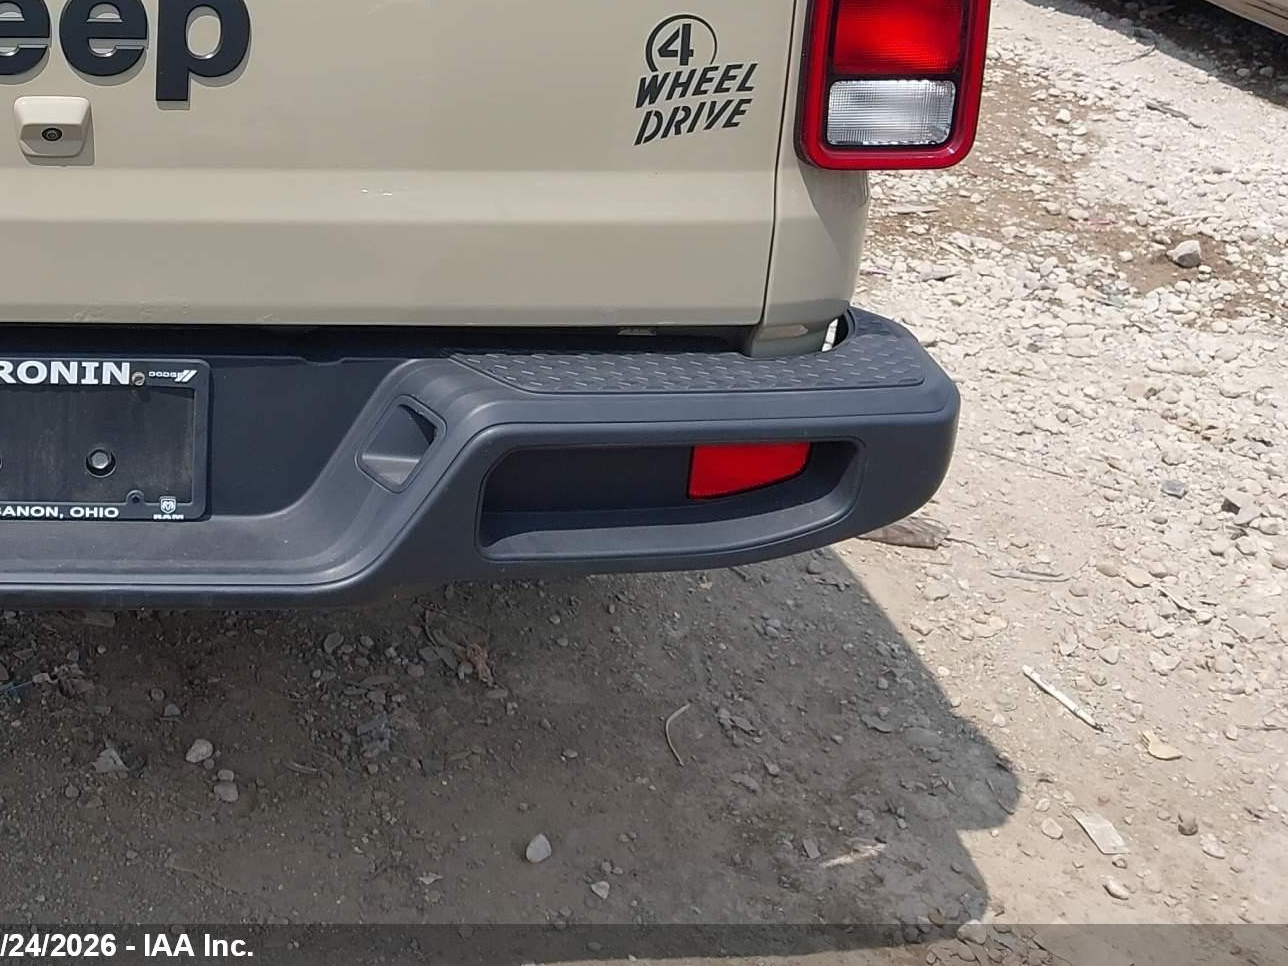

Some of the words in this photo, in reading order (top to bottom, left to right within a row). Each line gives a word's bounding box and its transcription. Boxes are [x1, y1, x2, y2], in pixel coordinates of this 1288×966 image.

[657, 23, 694, 66] 4
[635, 63, 759, 109] WHEEL
[633, 98, 753, 146] DRIVE
[69, 505, 120, 519] OHIO
